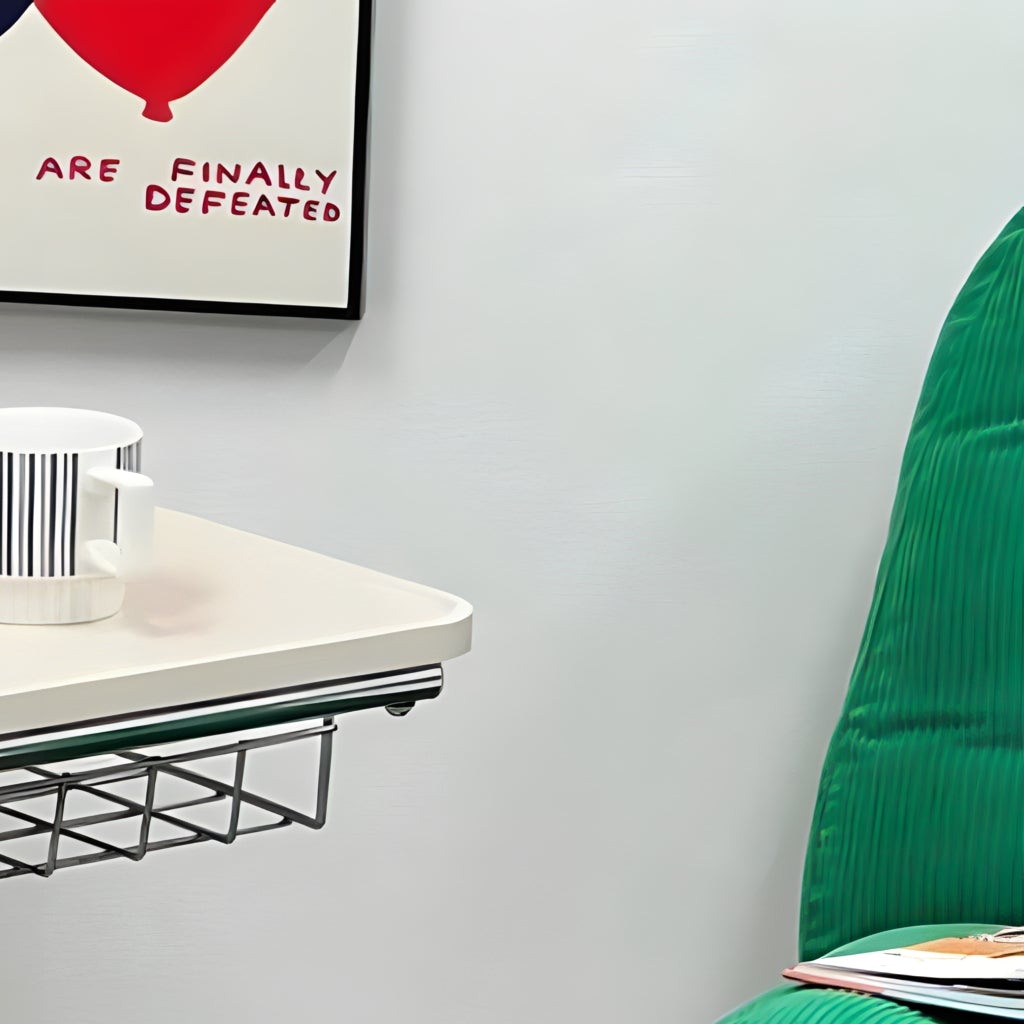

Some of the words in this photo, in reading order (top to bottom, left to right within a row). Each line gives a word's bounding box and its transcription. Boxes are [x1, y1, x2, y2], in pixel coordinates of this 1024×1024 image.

[36, 154, 121, 183] ARE
[170, 157, 337, 195] FINALLY
[144, 183, 341, 223] DEFEATED
